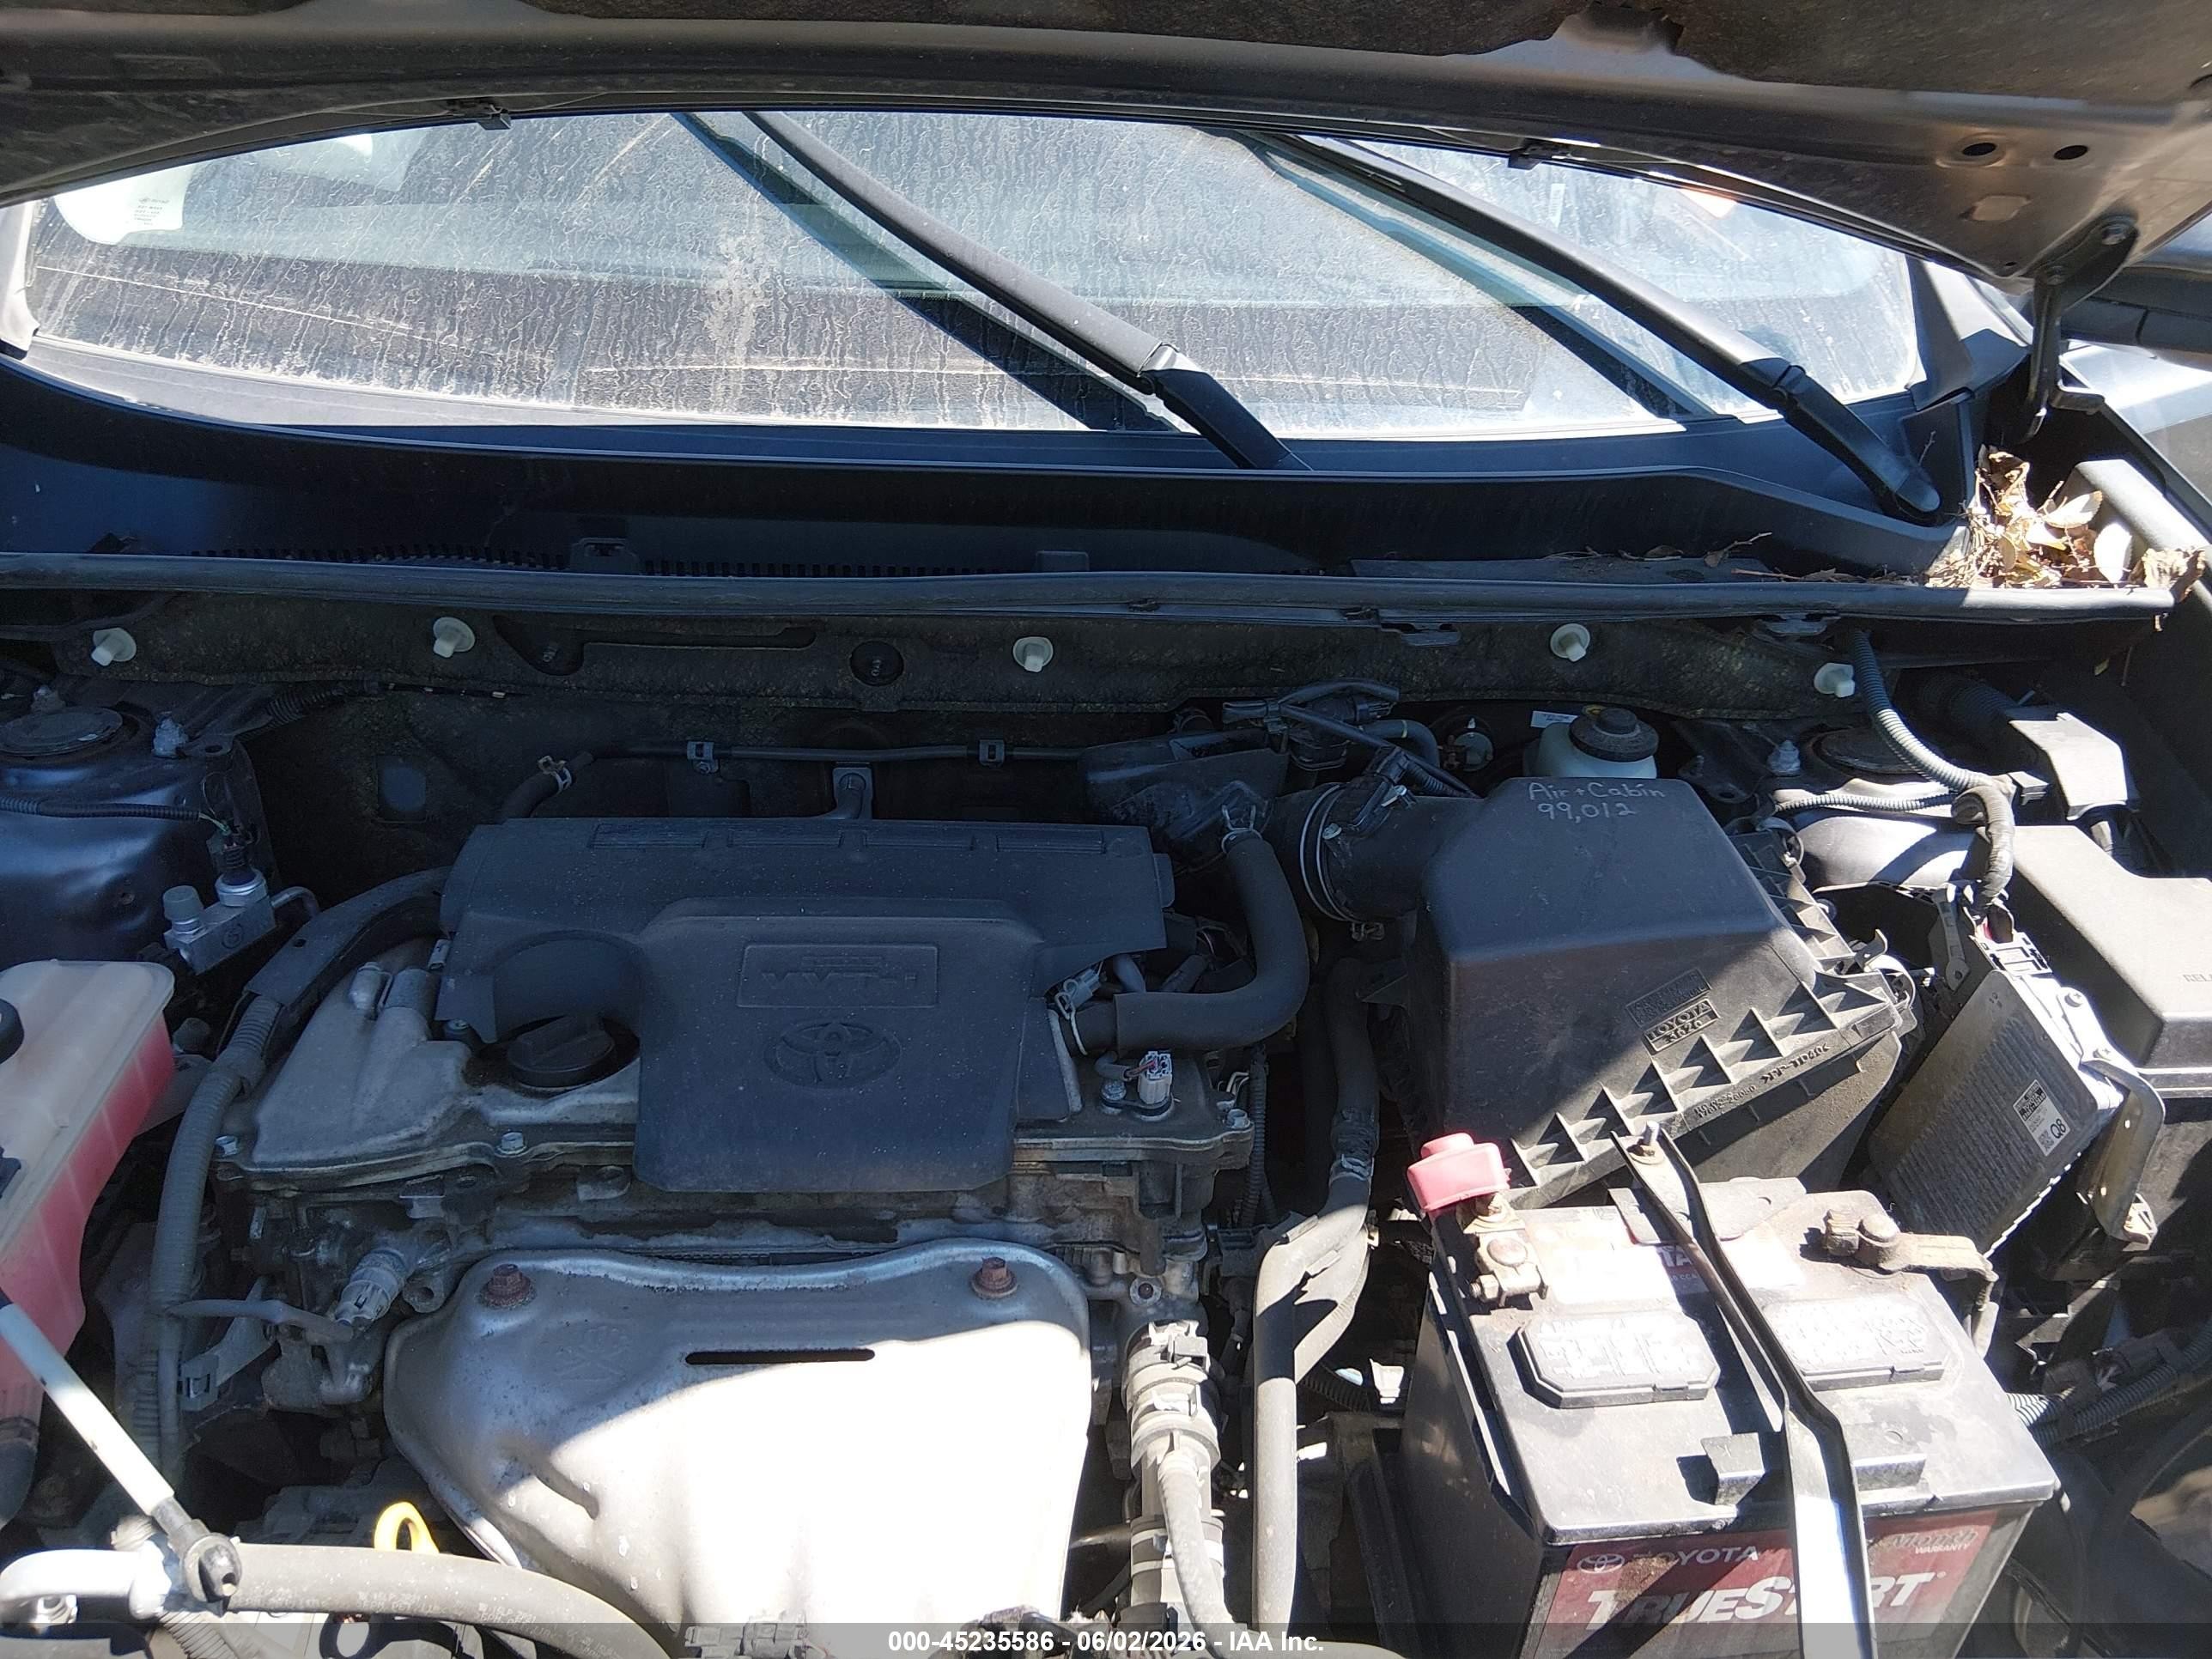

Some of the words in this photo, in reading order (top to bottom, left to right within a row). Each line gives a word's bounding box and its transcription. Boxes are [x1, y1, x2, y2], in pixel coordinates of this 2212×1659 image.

[1528, 782, 1569, 800] Air
[1589, 781, 1666, 798] Cabin
[1537, 801, 1638, 824] 99,012
[1648, 1001, 1712, 1039] TOYOTA
[2050, 1117, 2067, 1139] Q8
